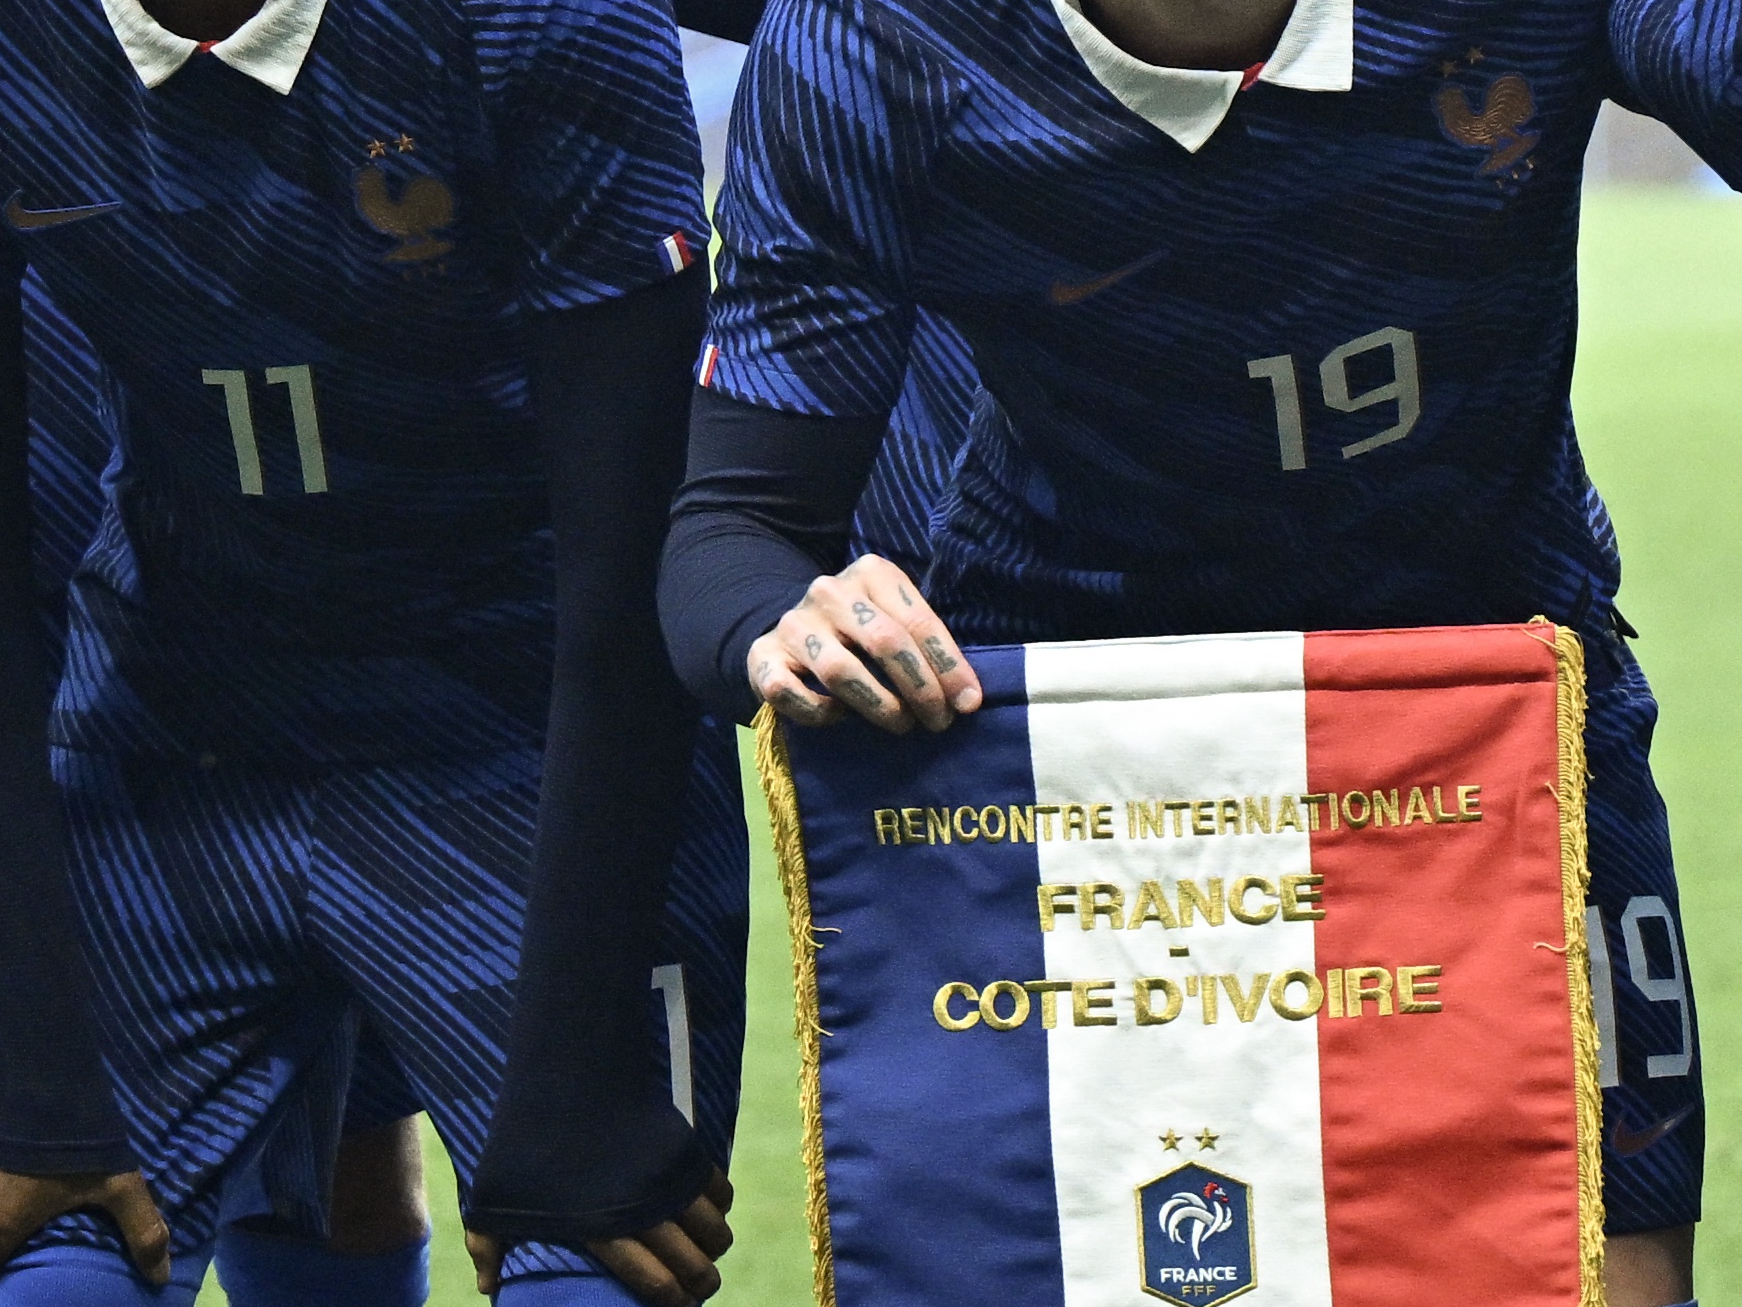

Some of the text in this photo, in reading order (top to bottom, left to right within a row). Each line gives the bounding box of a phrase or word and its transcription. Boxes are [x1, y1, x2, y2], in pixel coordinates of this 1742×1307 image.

[201, 364, 328, 496] 11
[1247, 326, 1421, 472] 19
[873, 784, 1483, 845] RENCONTRE INTERNATIONALE
[1036, 873, 1326, 933] FRANCE
[932, 965, 1443, 1032] COTE D'IVOIRE
[1585, 895, 1693, 1089] 19
[1160, 1266, 1238, 1283] FRANCE
[1181, 1285, 1217, 1297] FFF
